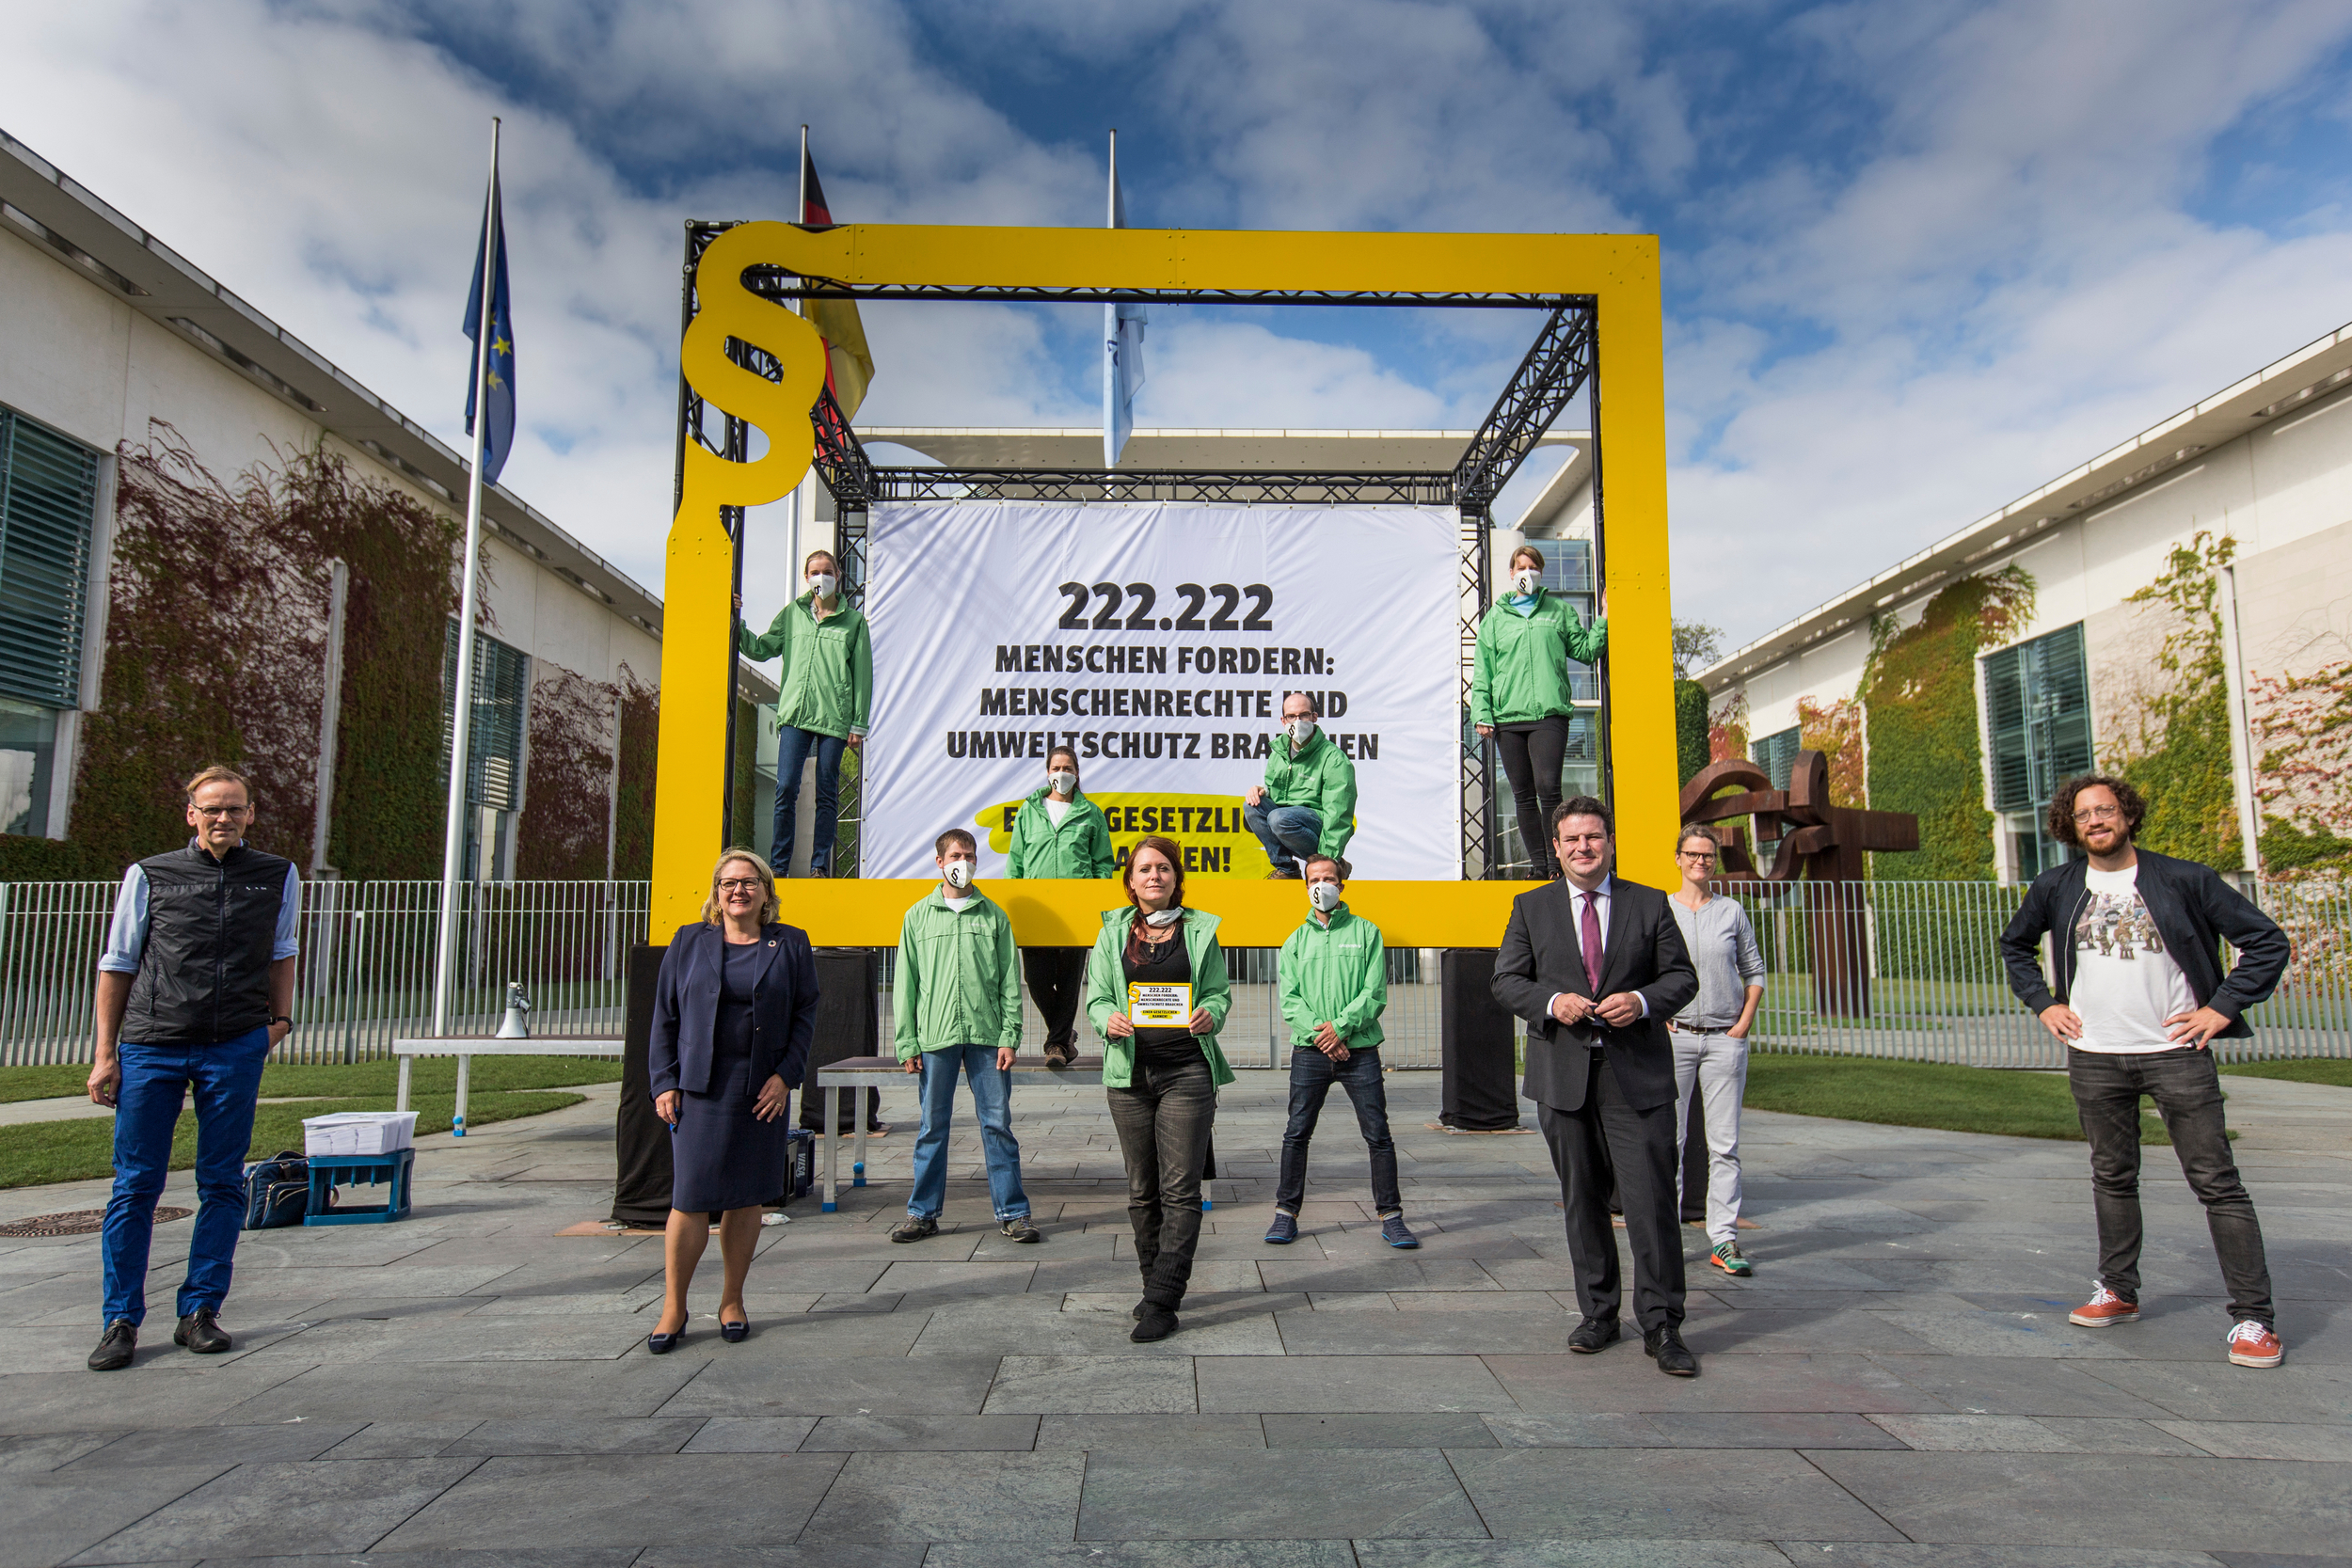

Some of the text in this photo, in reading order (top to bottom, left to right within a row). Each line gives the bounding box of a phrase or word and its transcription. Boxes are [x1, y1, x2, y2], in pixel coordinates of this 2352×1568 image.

[1058, 581, 1273, 631] 222.222
[995, 644, 1335, 675] MENSCHEN FORDERN:
[979, 688, 1272, 718] MENSCHENRECHTE
[1211, 733, 1378, 760] BRAEN
[795, 1152, 806, 1179] VILSA
